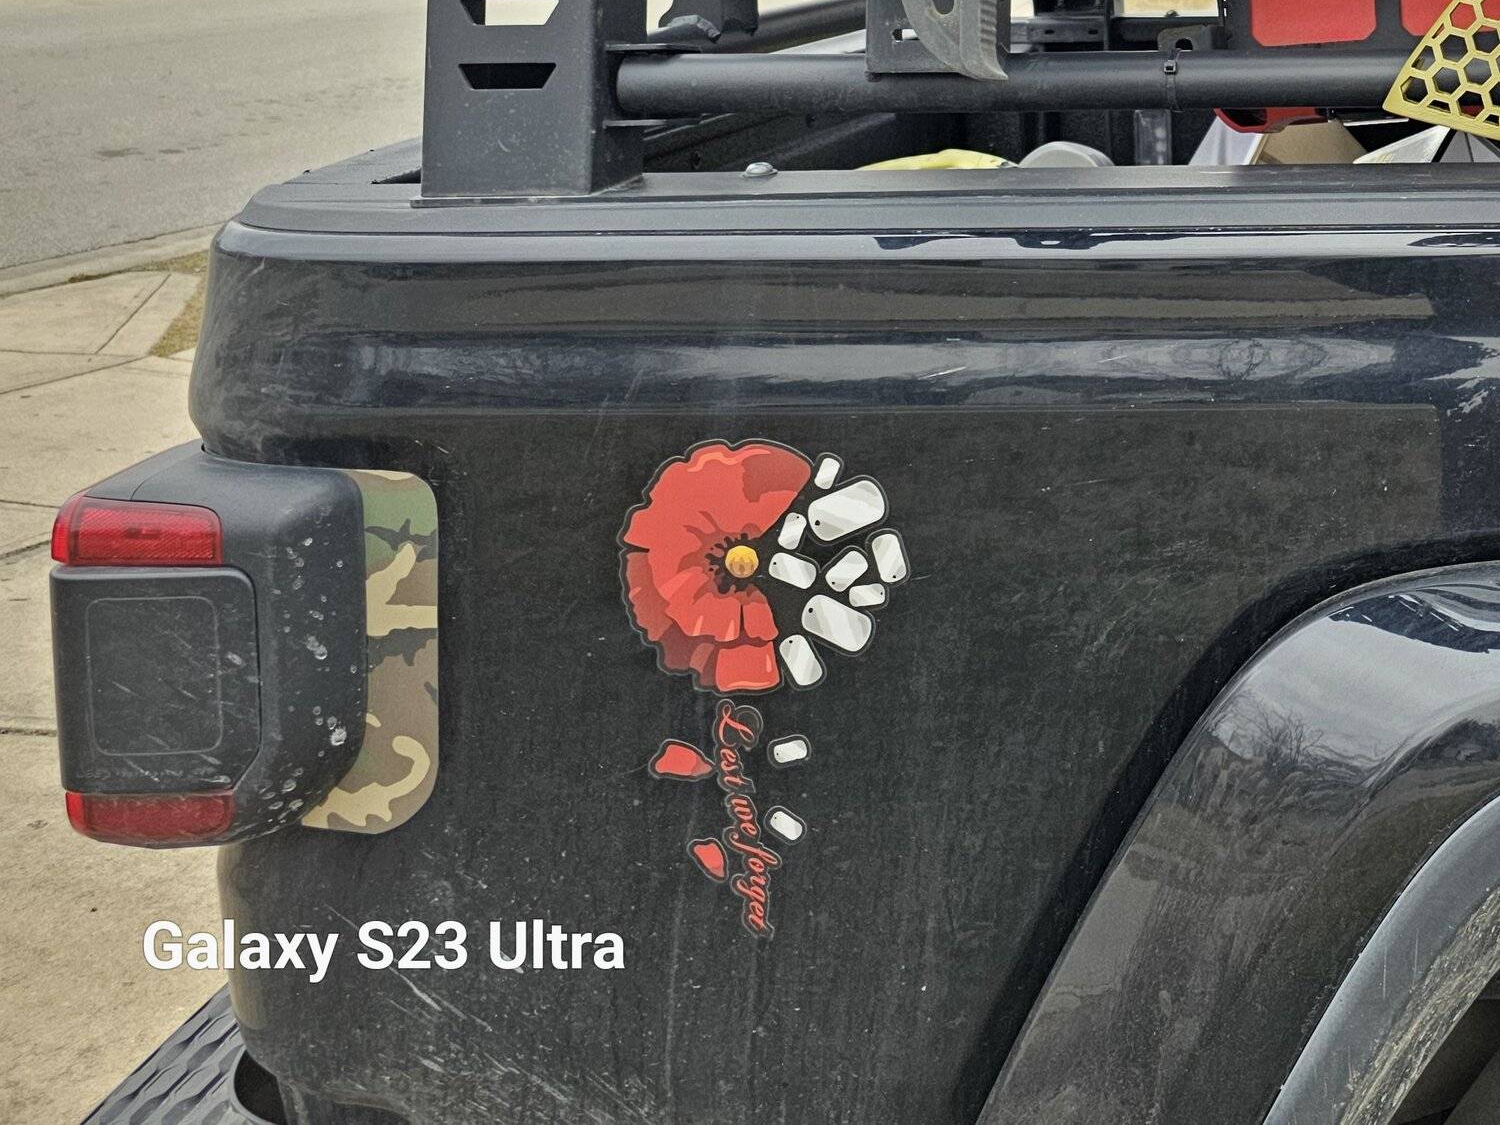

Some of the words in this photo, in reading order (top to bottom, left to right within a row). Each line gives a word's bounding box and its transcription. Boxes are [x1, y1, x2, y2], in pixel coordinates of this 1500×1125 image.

[719, 703, 755, 787] Lest
[731, 798, 758, 837] we
[729, 832, 779, 935] forget
